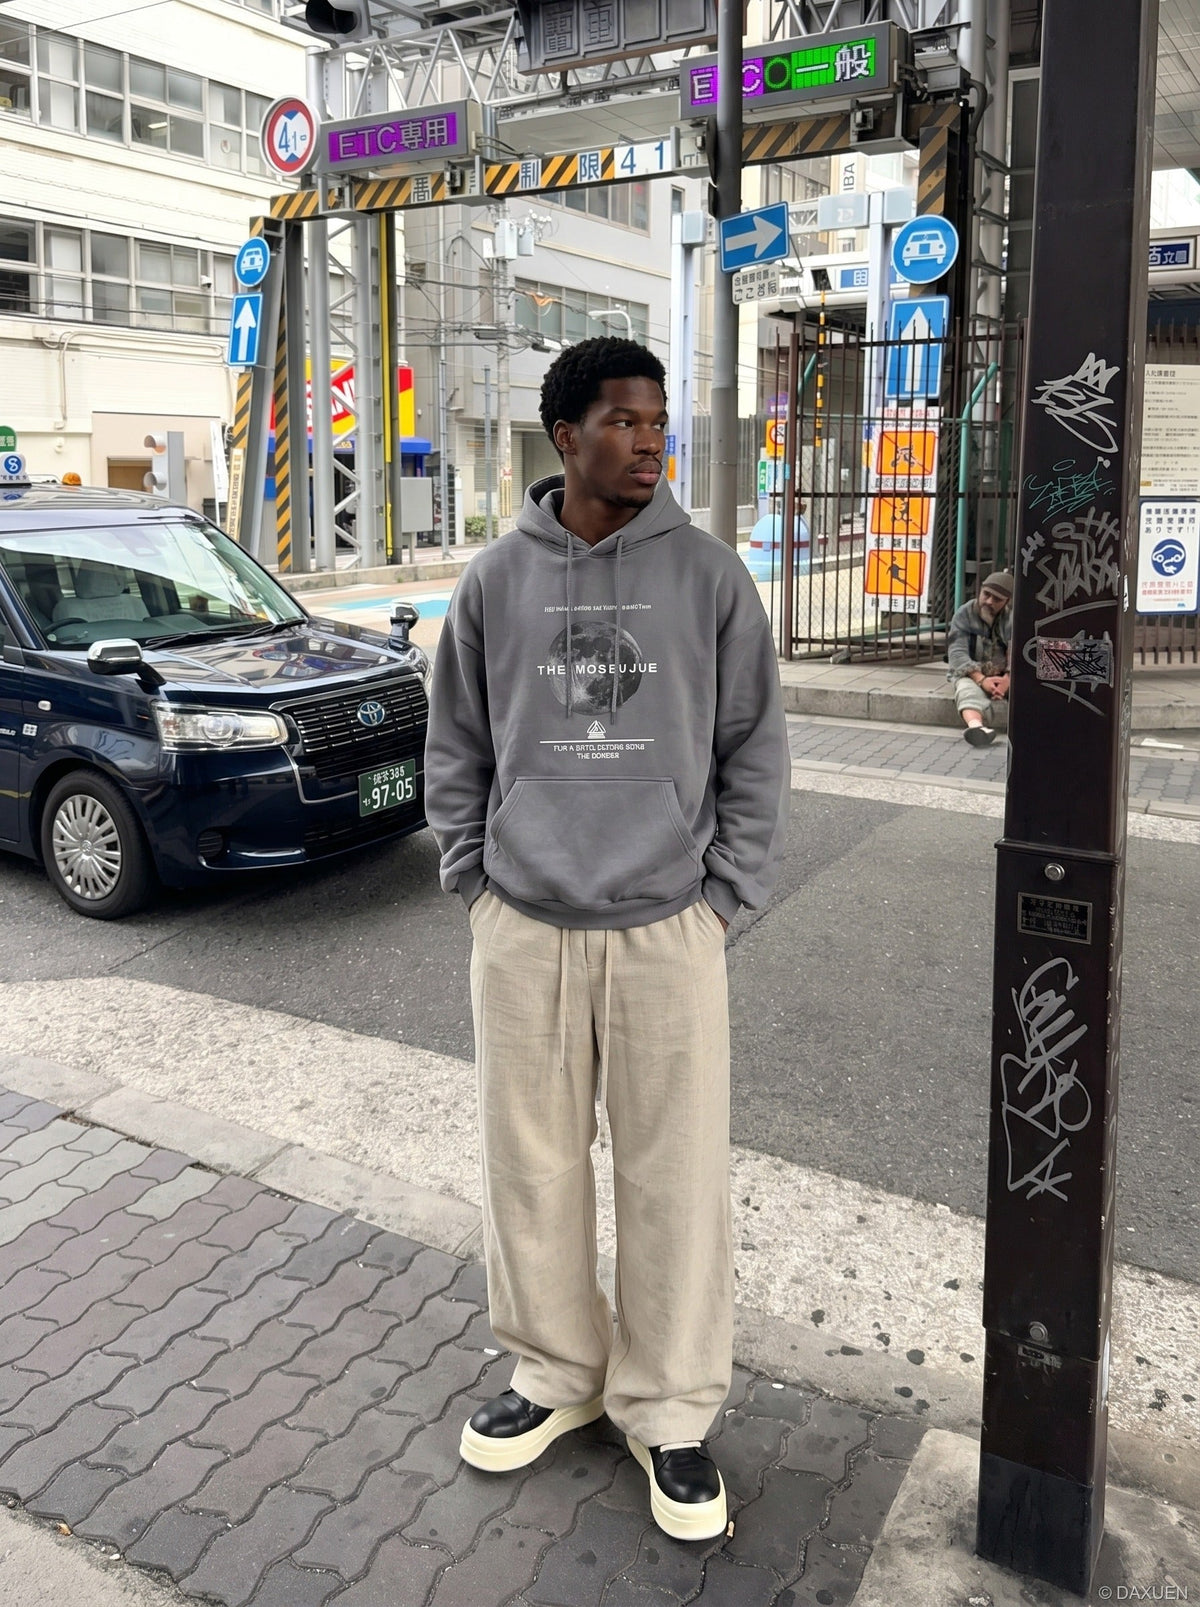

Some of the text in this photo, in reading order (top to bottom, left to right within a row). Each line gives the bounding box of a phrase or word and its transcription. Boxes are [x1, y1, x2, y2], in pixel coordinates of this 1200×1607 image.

[338, 116, 449, 160] ETC専用
[537, 664, 566, 676] THE
[576, 752, 590, 760] THE
